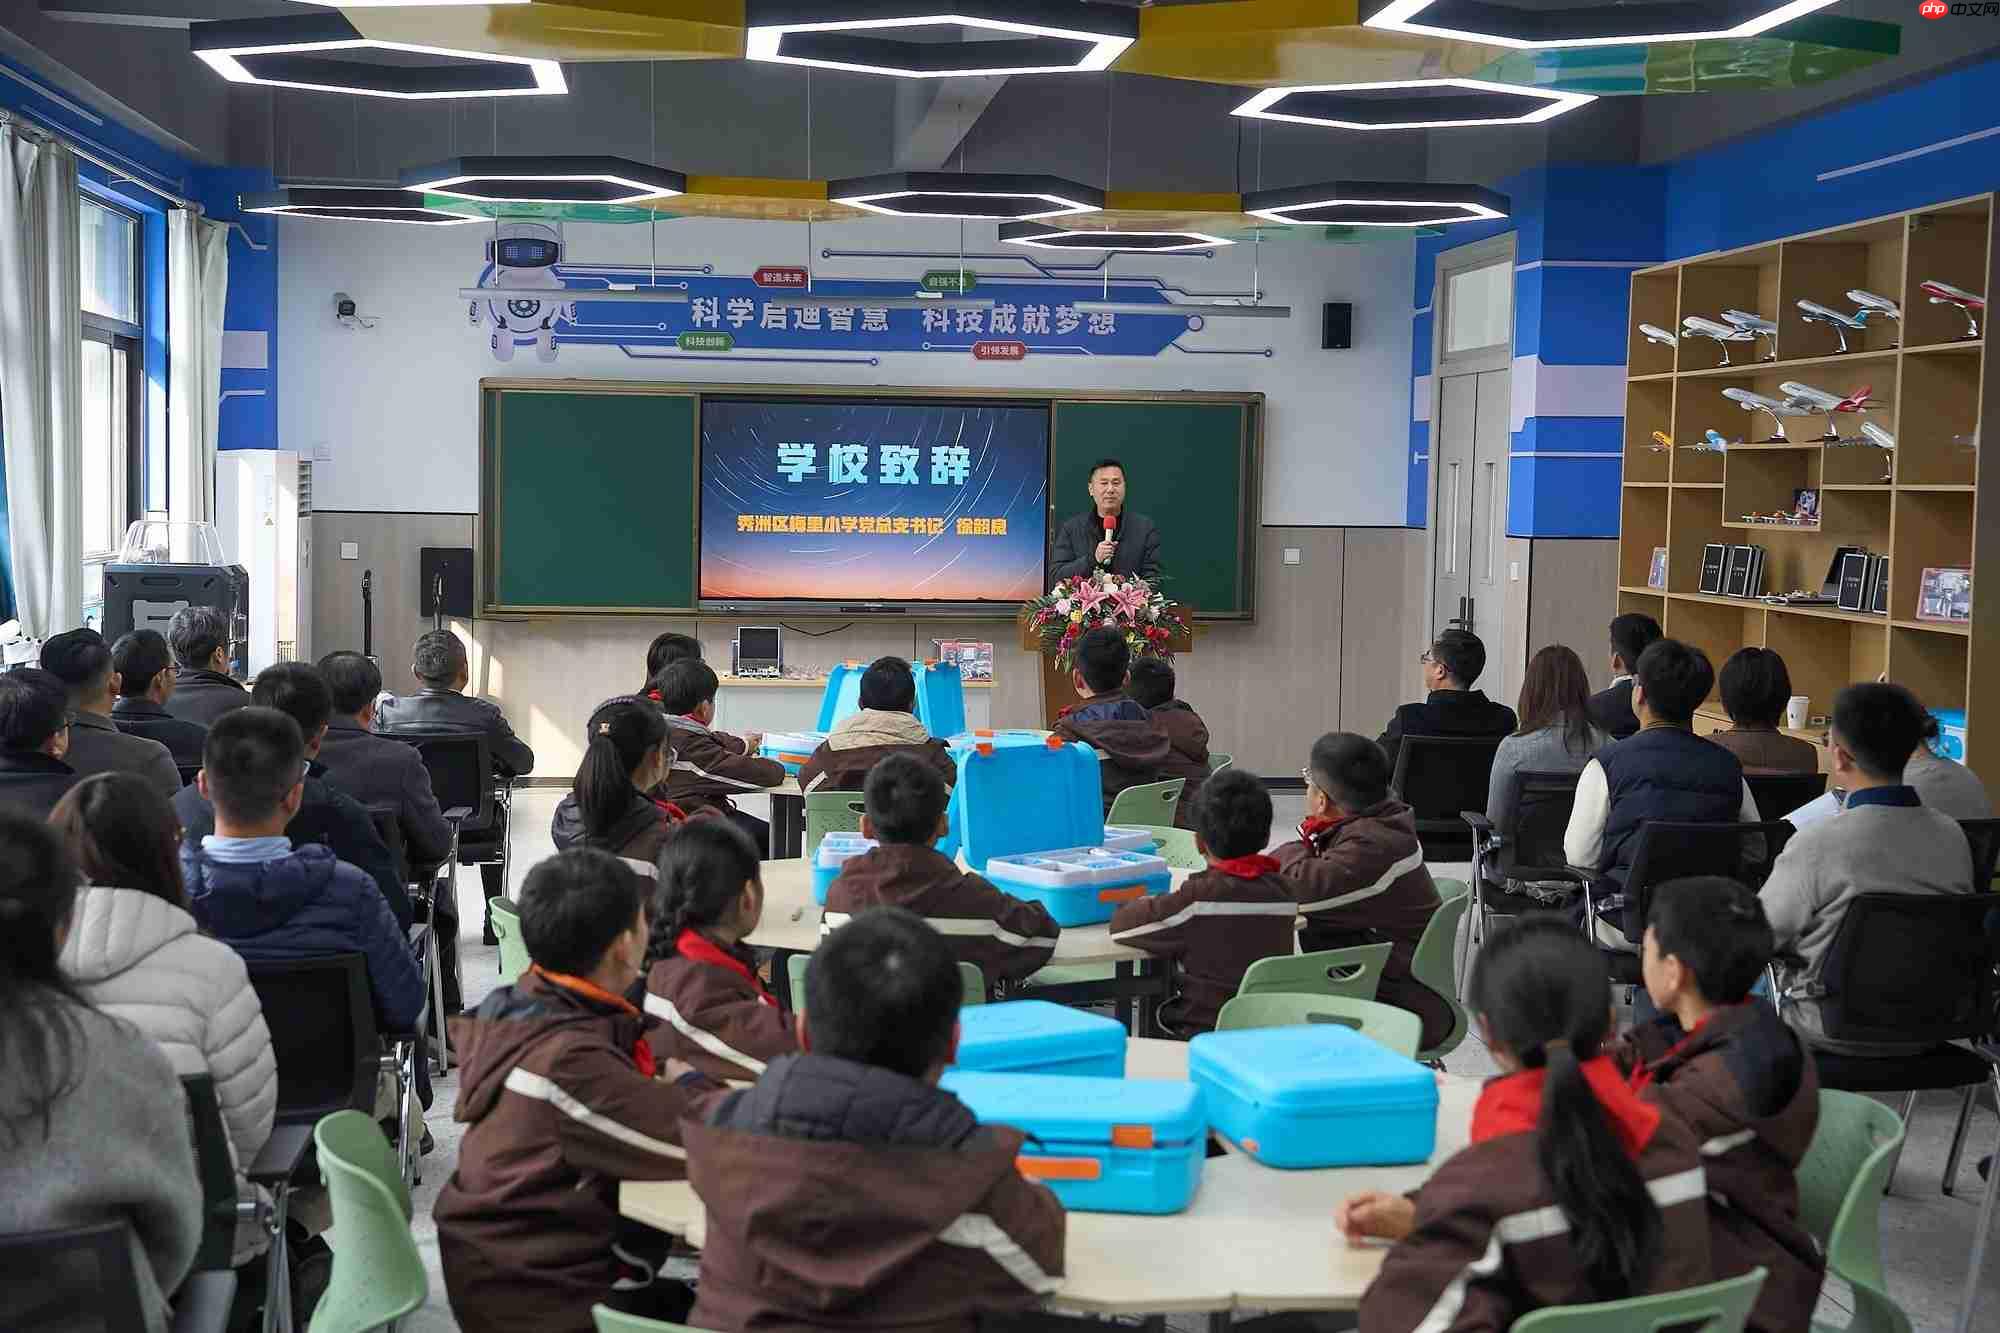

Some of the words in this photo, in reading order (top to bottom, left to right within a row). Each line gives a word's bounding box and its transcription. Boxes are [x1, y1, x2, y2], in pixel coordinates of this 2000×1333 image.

[692, 296, 889, 332] 科学启迪智慧
[921, 303, 1116, 336] 科技成就梦想
[777, 443, 970, 485] 学校致辞
